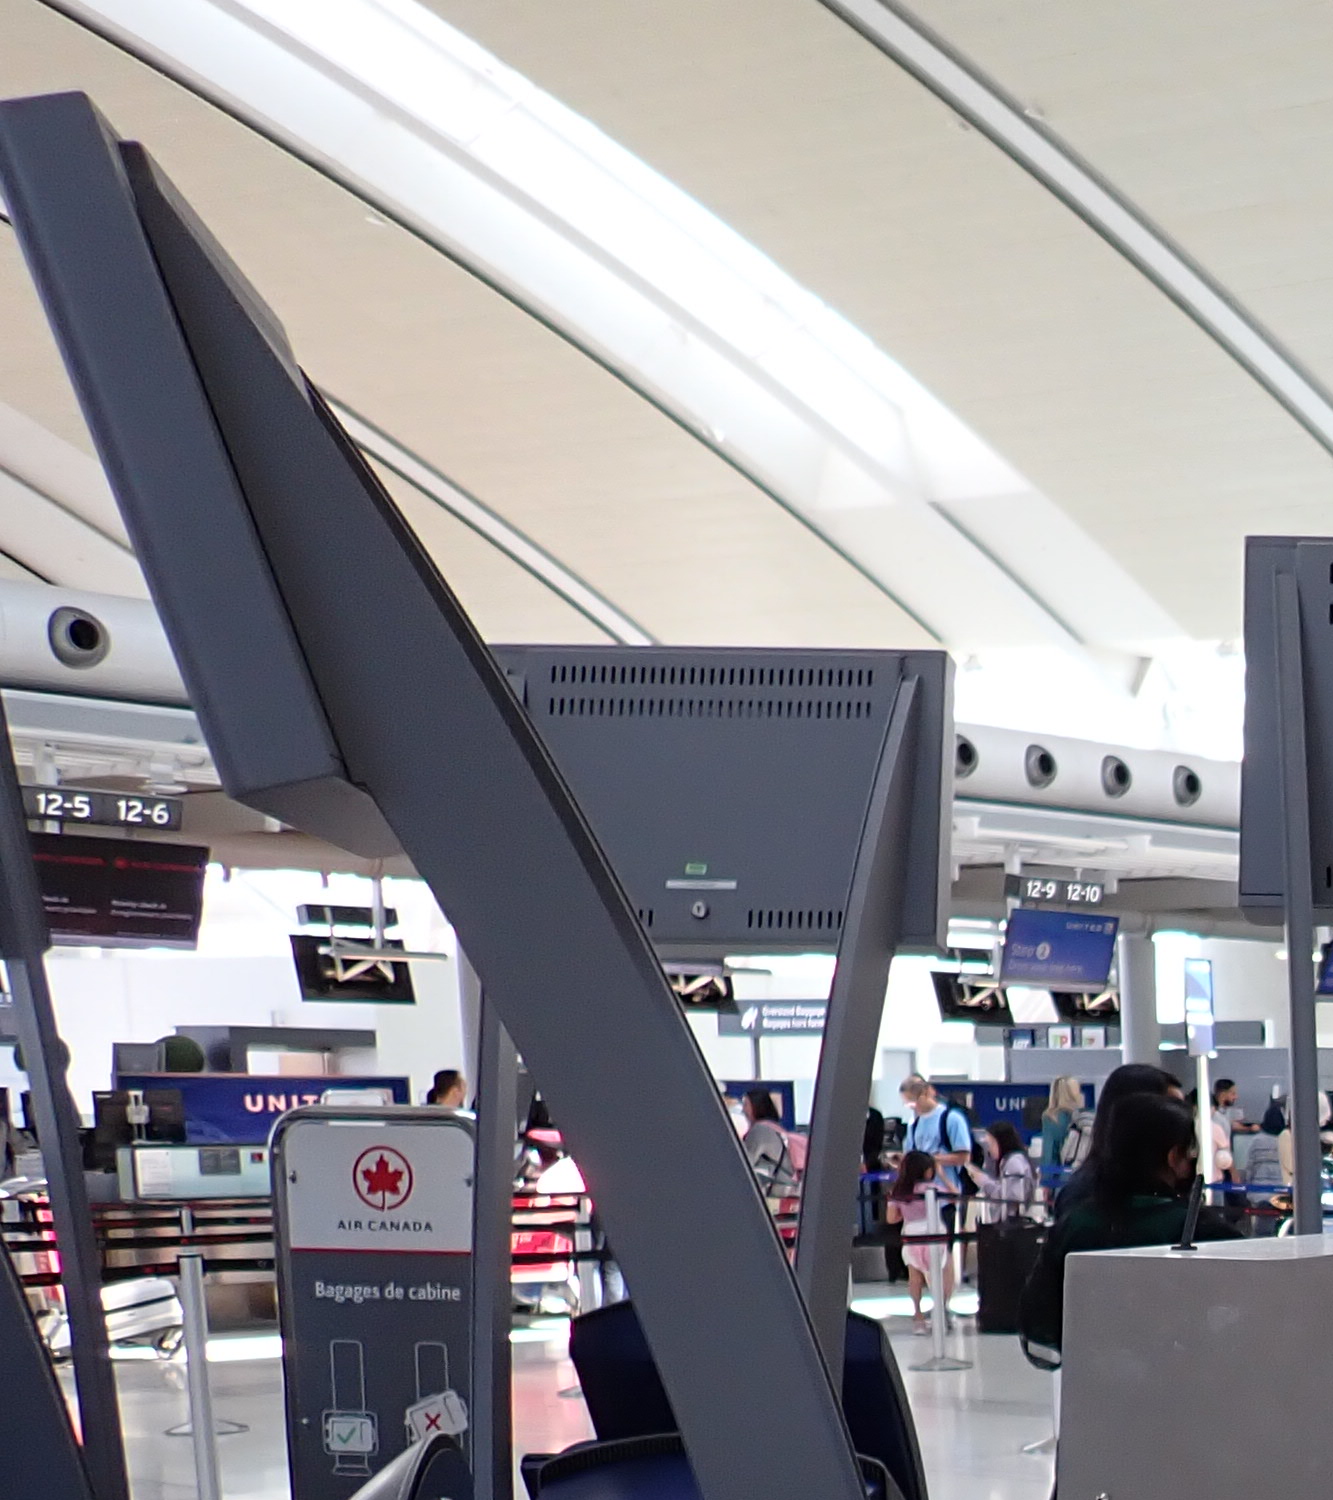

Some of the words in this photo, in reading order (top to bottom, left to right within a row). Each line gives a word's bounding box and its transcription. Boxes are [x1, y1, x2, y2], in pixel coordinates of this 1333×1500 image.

[37, 793, 91, 818] 12-5
[117, 799, 170, 825] 12-6
[1027, 880, 1057, 899] 12-9
[1066, 883, 1100, 903] 12-10
[338, 1220, 364, 1232] AIR
[368, 1220, 433, 1233] CANADA
[315, 1281, 380, 1304] Bagages
[384, 1282, 404, 1299] de
[408, 1282, 461, 1301] cabine
